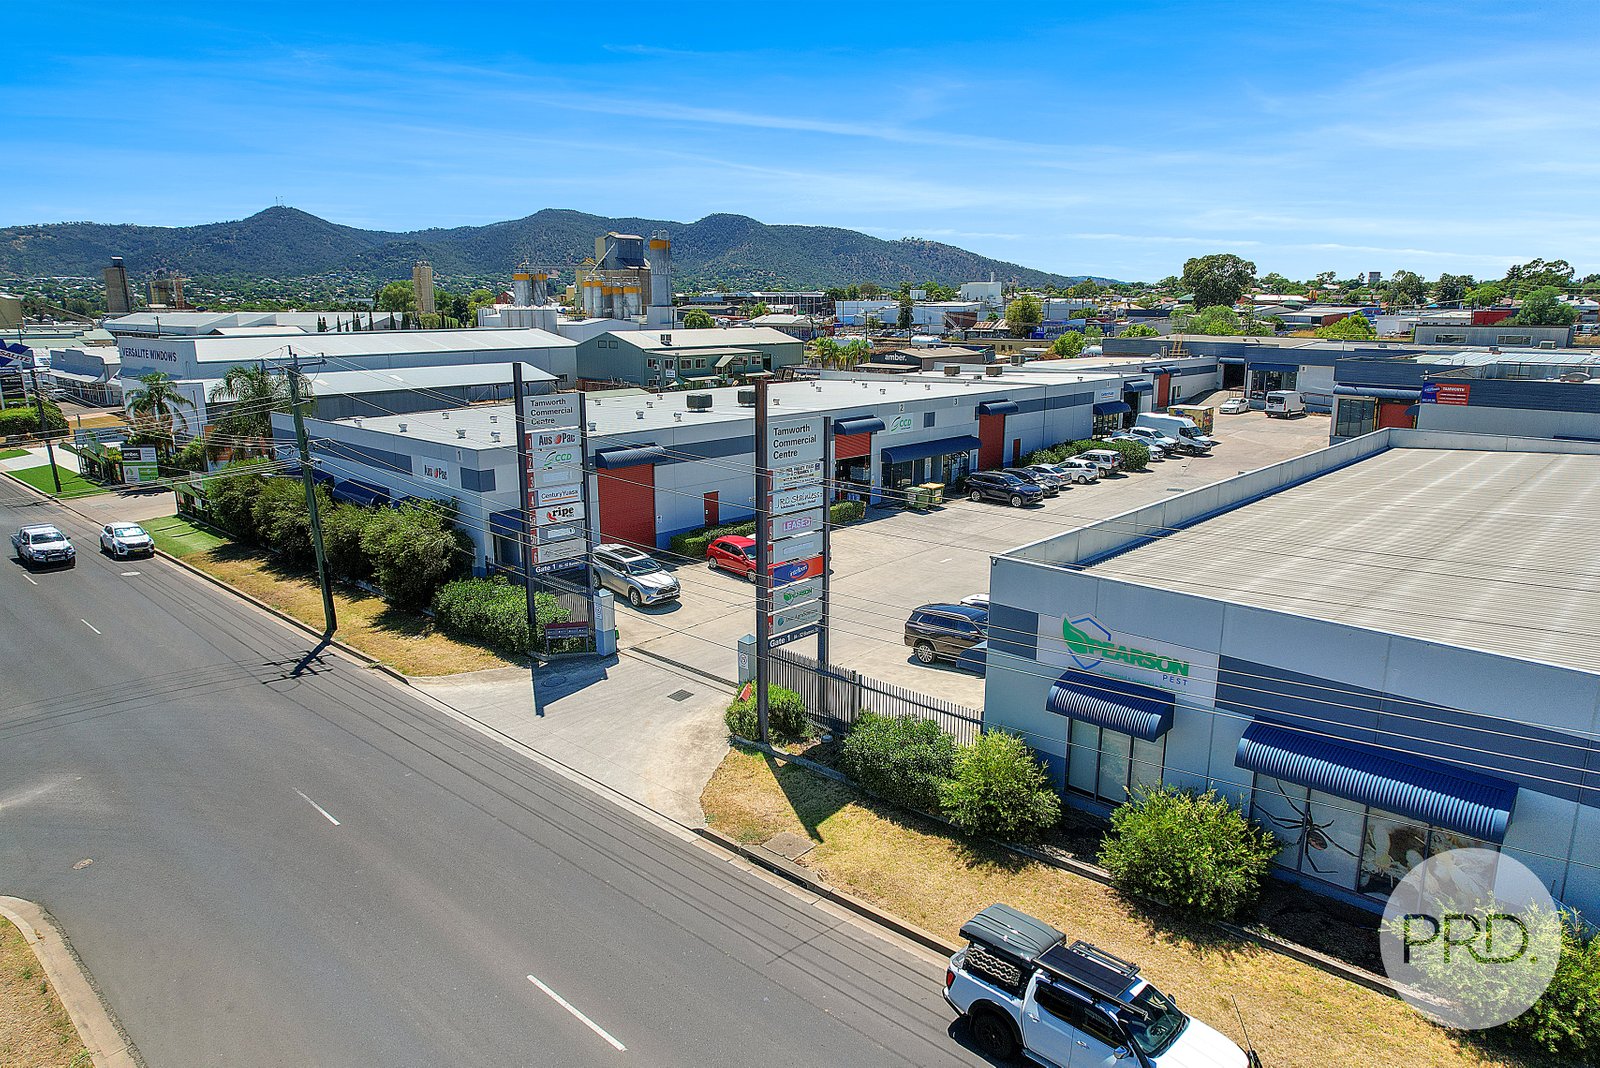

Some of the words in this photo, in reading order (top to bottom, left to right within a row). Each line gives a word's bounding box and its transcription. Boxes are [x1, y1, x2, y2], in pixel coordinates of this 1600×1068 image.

[122, 347, 149, 359] VERSALITE
[150, 352, 177, 362] WINDOWS
[530, 398, 566, 407] Tamworth
[530, 406, 573, 417] Commercial
[531, 418, 555, 426] Centre
[773, 424, 811, 436] Tamworth
[538, 435, 553, 446] Aus
[562, 432, 576, 444] Pac
[773, 434, 817, 449] Commercial
[773, 449, 798, 460] Centre
[552, 506, 574, 517] ripe
[783, 517, 812, 532] LEASED
[535, 564, 551, 573] Gate
[769, 635, 785, 648] Gate
[1087, 638, 1190, 676] PEARSON
[1162, 674, 1189, 686] PEST
